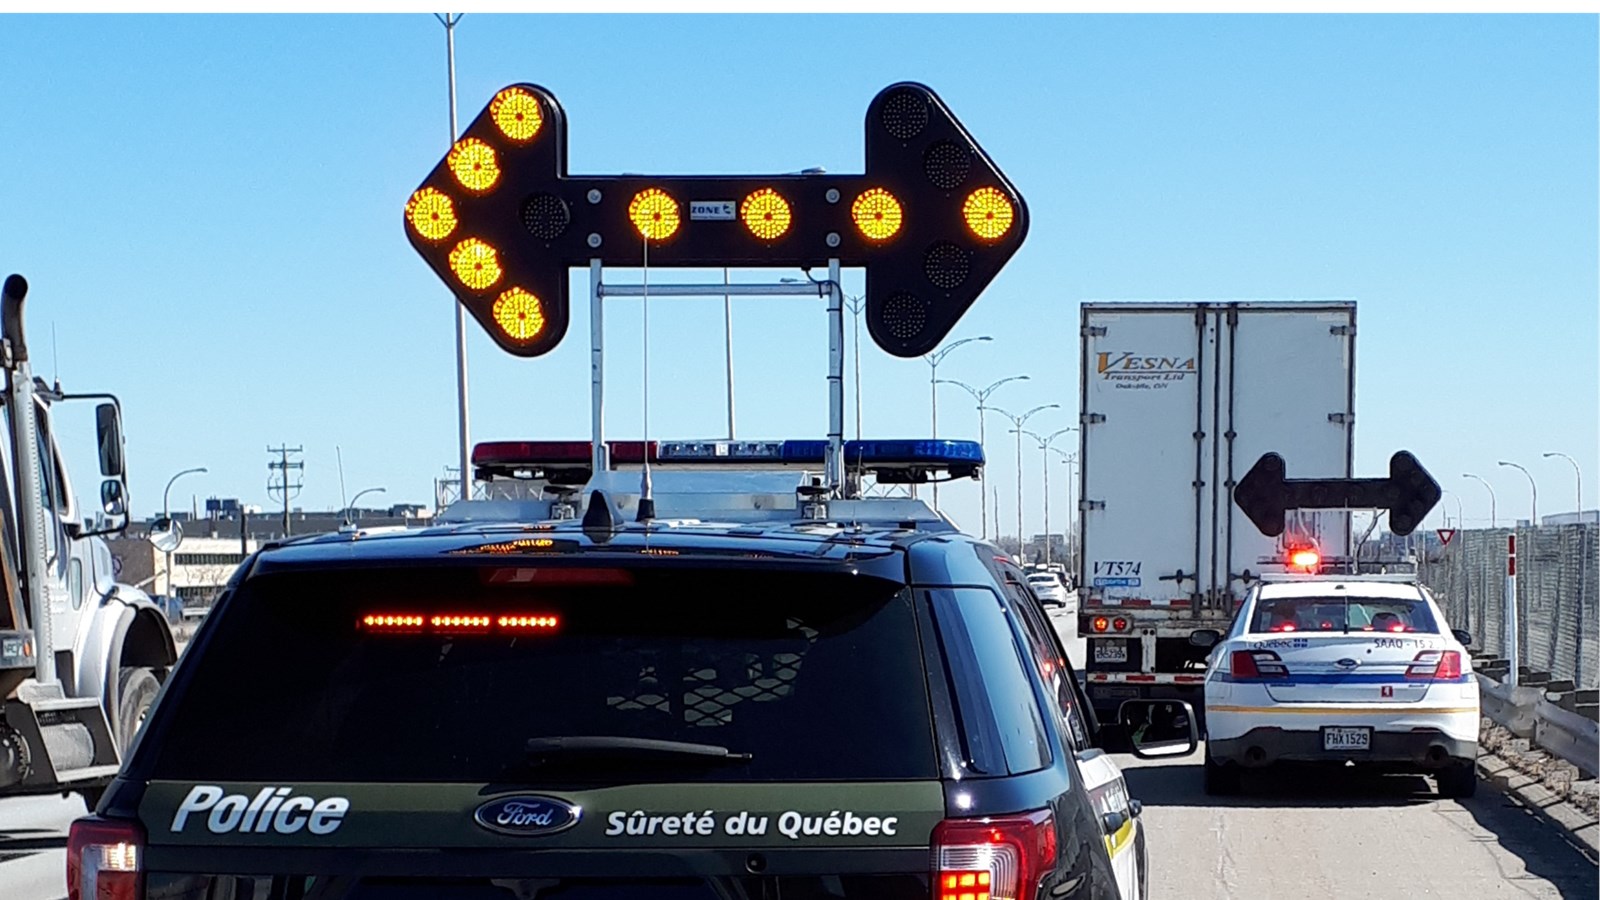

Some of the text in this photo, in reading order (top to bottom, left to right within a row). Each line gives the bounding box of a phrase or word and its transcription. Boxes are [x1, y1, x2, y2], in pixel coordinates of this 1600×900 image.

[691, 206, 721, 214] ZONE
[1096, 352, 1195, 374] VESNA
[1104, 373, 1185, 381] Transport Ltd
[1094, 561, 1141, 576] VT574
[1374, 639, 1404, 649] SAAQ
[1326, 733, 1368, 745] FHX1529
[170, 785, 350, 835] Police
[497, 802, 552, 827] Ford
[606, 810, 898, 839] Sûreté du Québec
